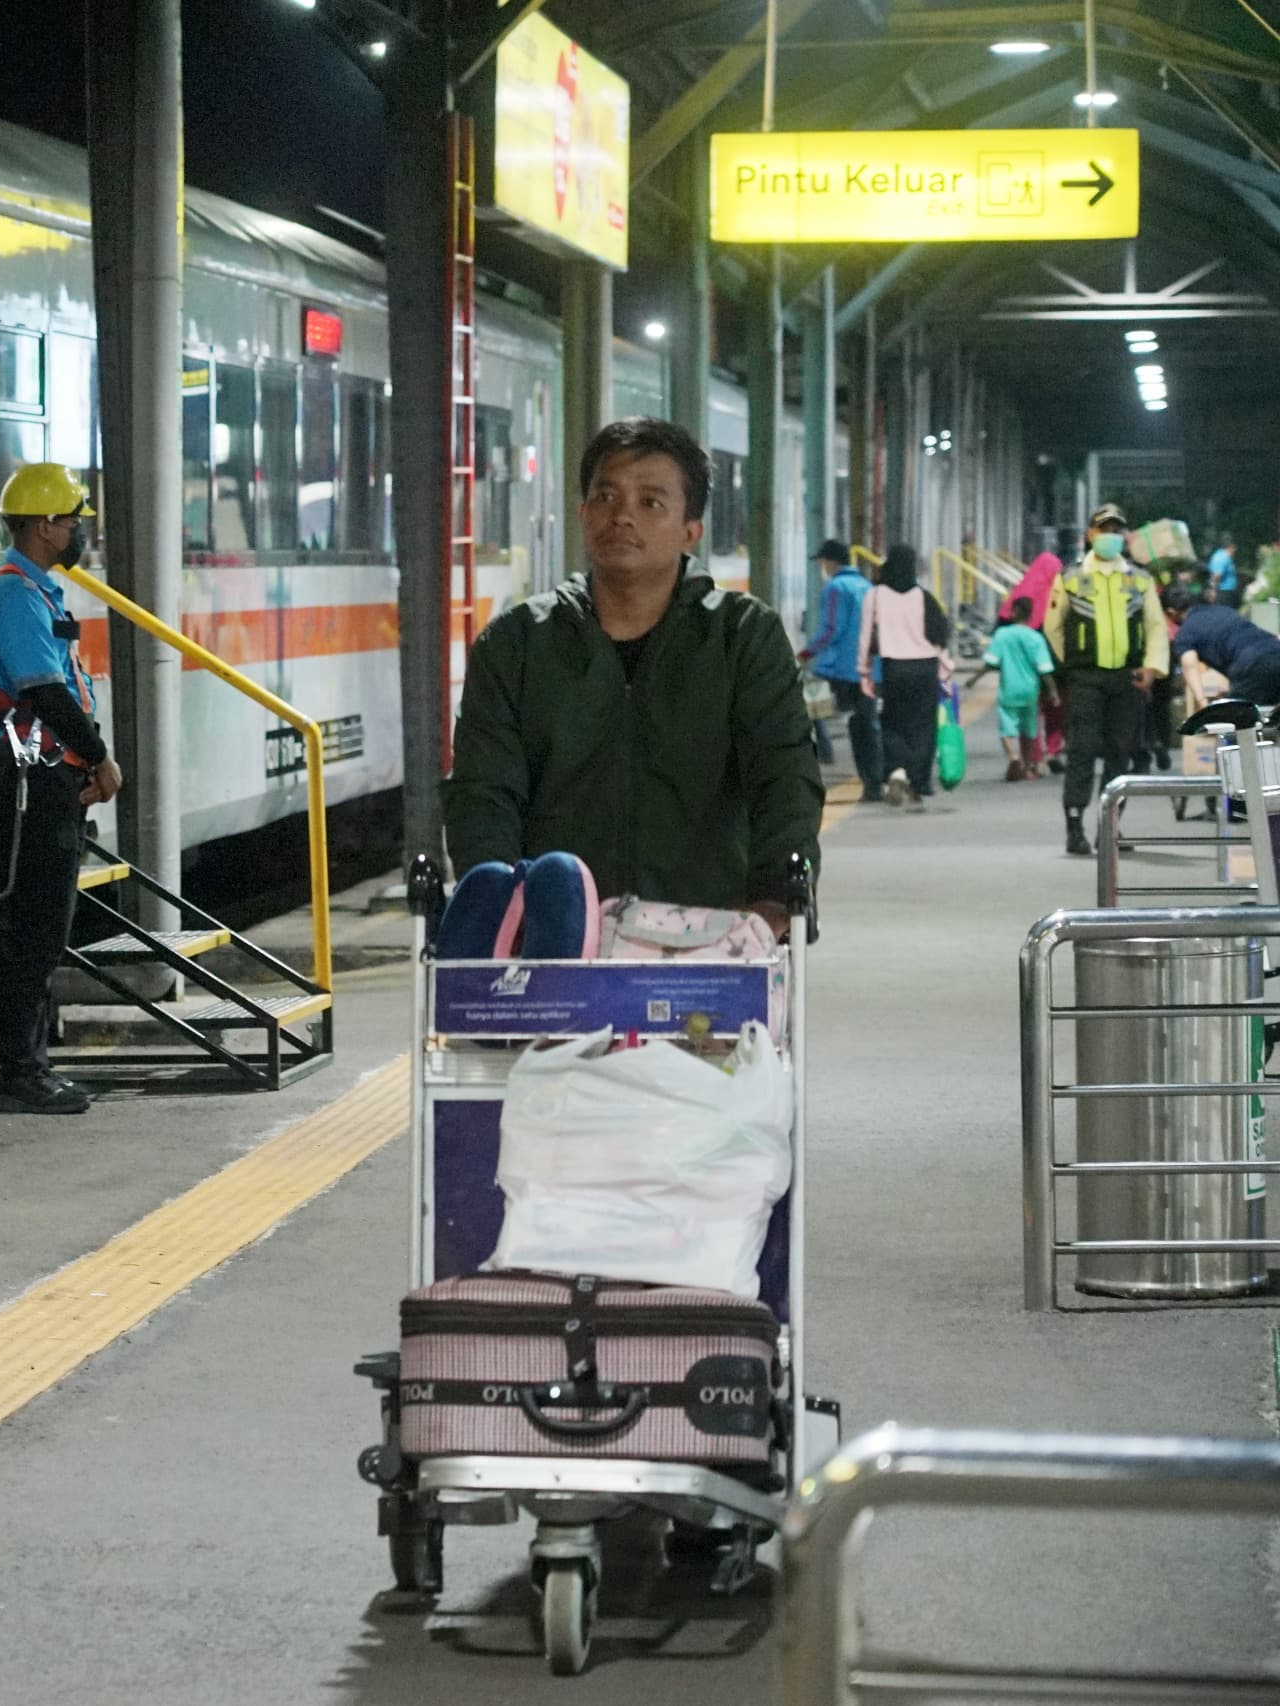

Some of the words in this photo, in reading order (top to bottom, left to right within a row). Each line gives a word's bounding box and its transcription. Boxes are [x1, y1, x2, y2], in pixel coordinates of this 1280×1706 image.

[735, 163, 831, 194] Pintu
[845, 162, 964, 194] Keluar
[482, 1385, 520, 1403] LO
[699, 1386, 755, 1405] POLO
